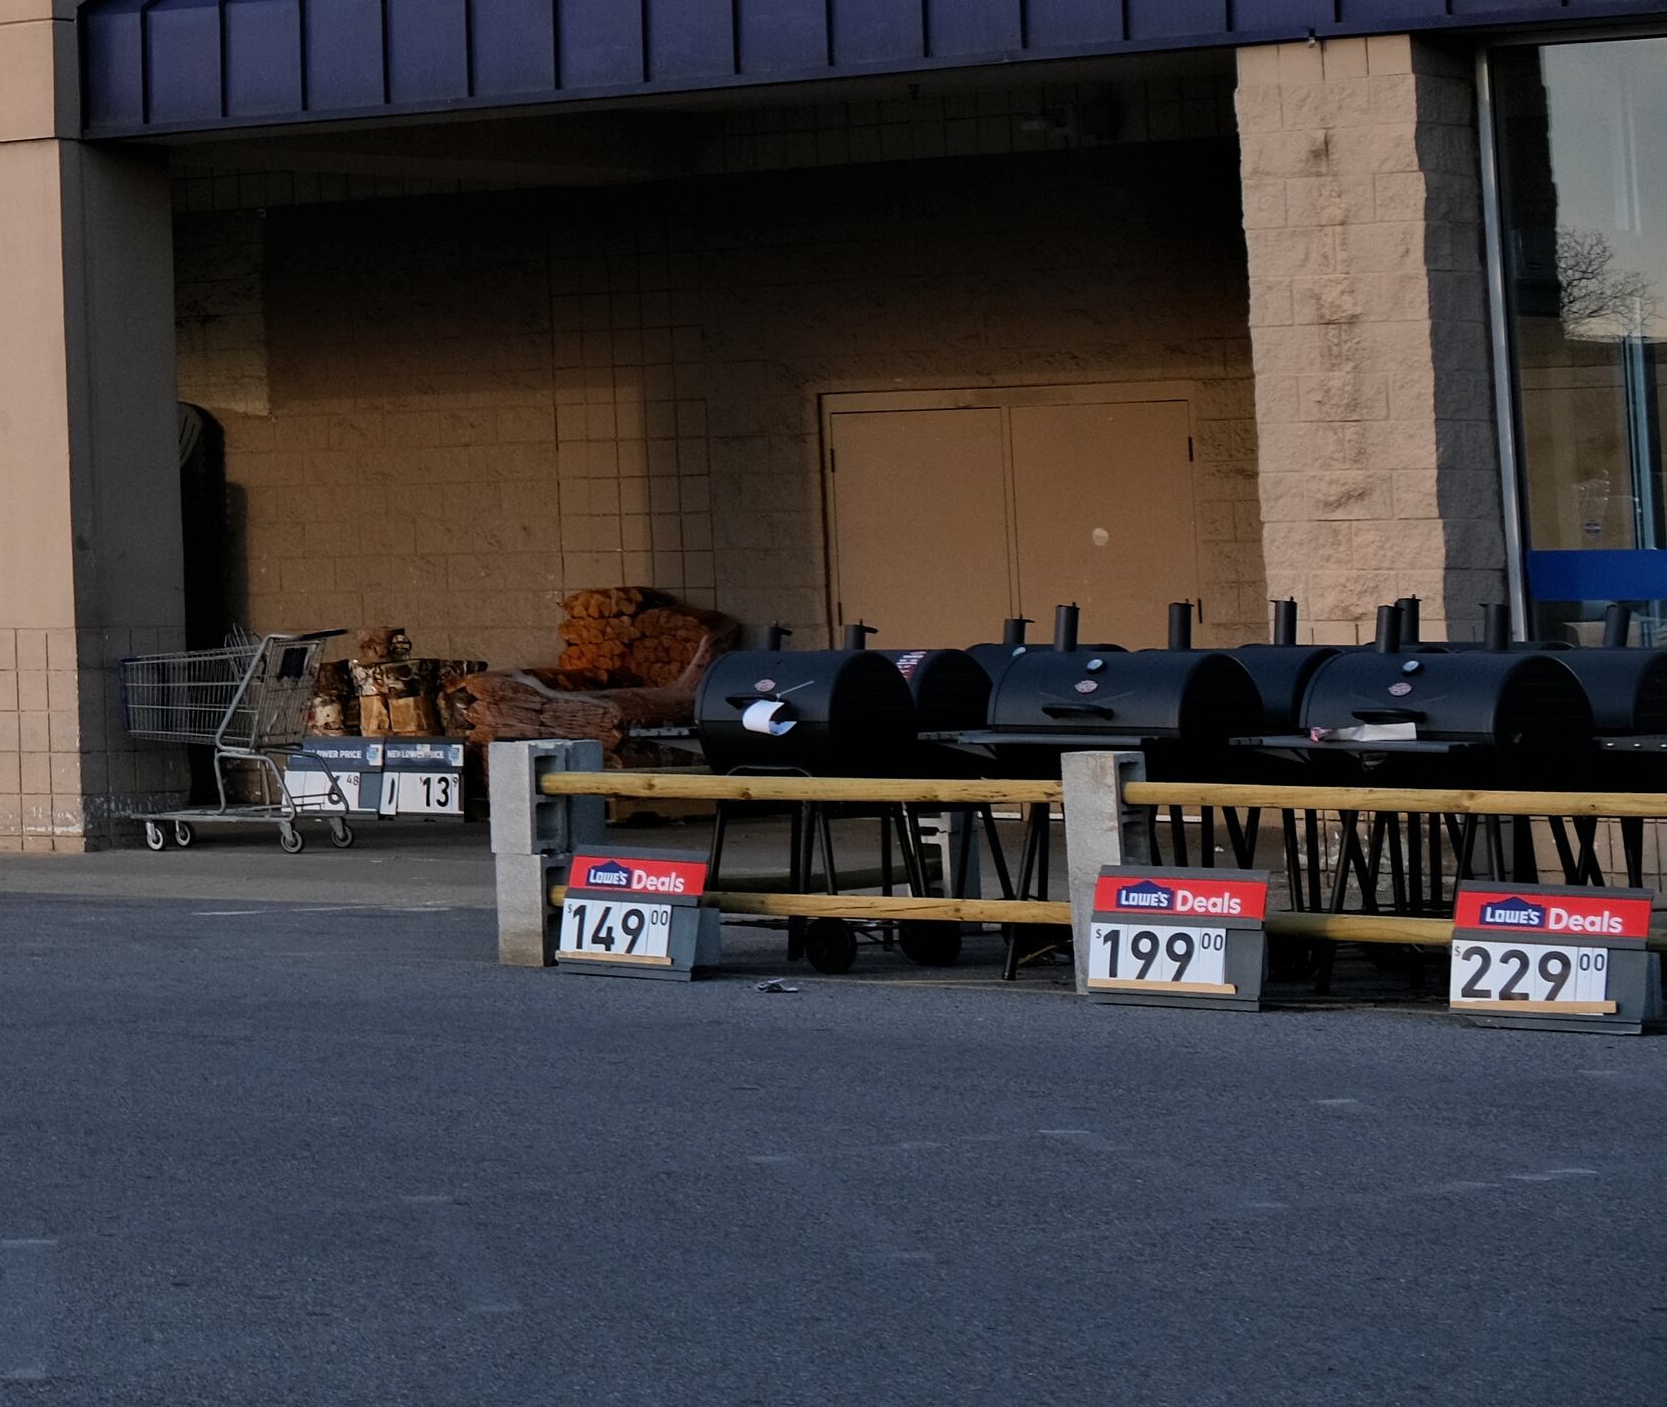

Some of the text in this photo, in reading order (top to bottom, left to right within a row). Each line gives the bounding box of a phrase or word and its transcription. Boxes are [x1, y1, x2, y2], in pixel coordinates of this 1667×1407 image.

[340, 750, 363, 760] PRICE
[589, 868, 685, 893] LOWE'S Deals
[1120, 890, 1242, 914] LOWE'S Deals
[1485, 906, 1623, 934] LOWE'S Deals
